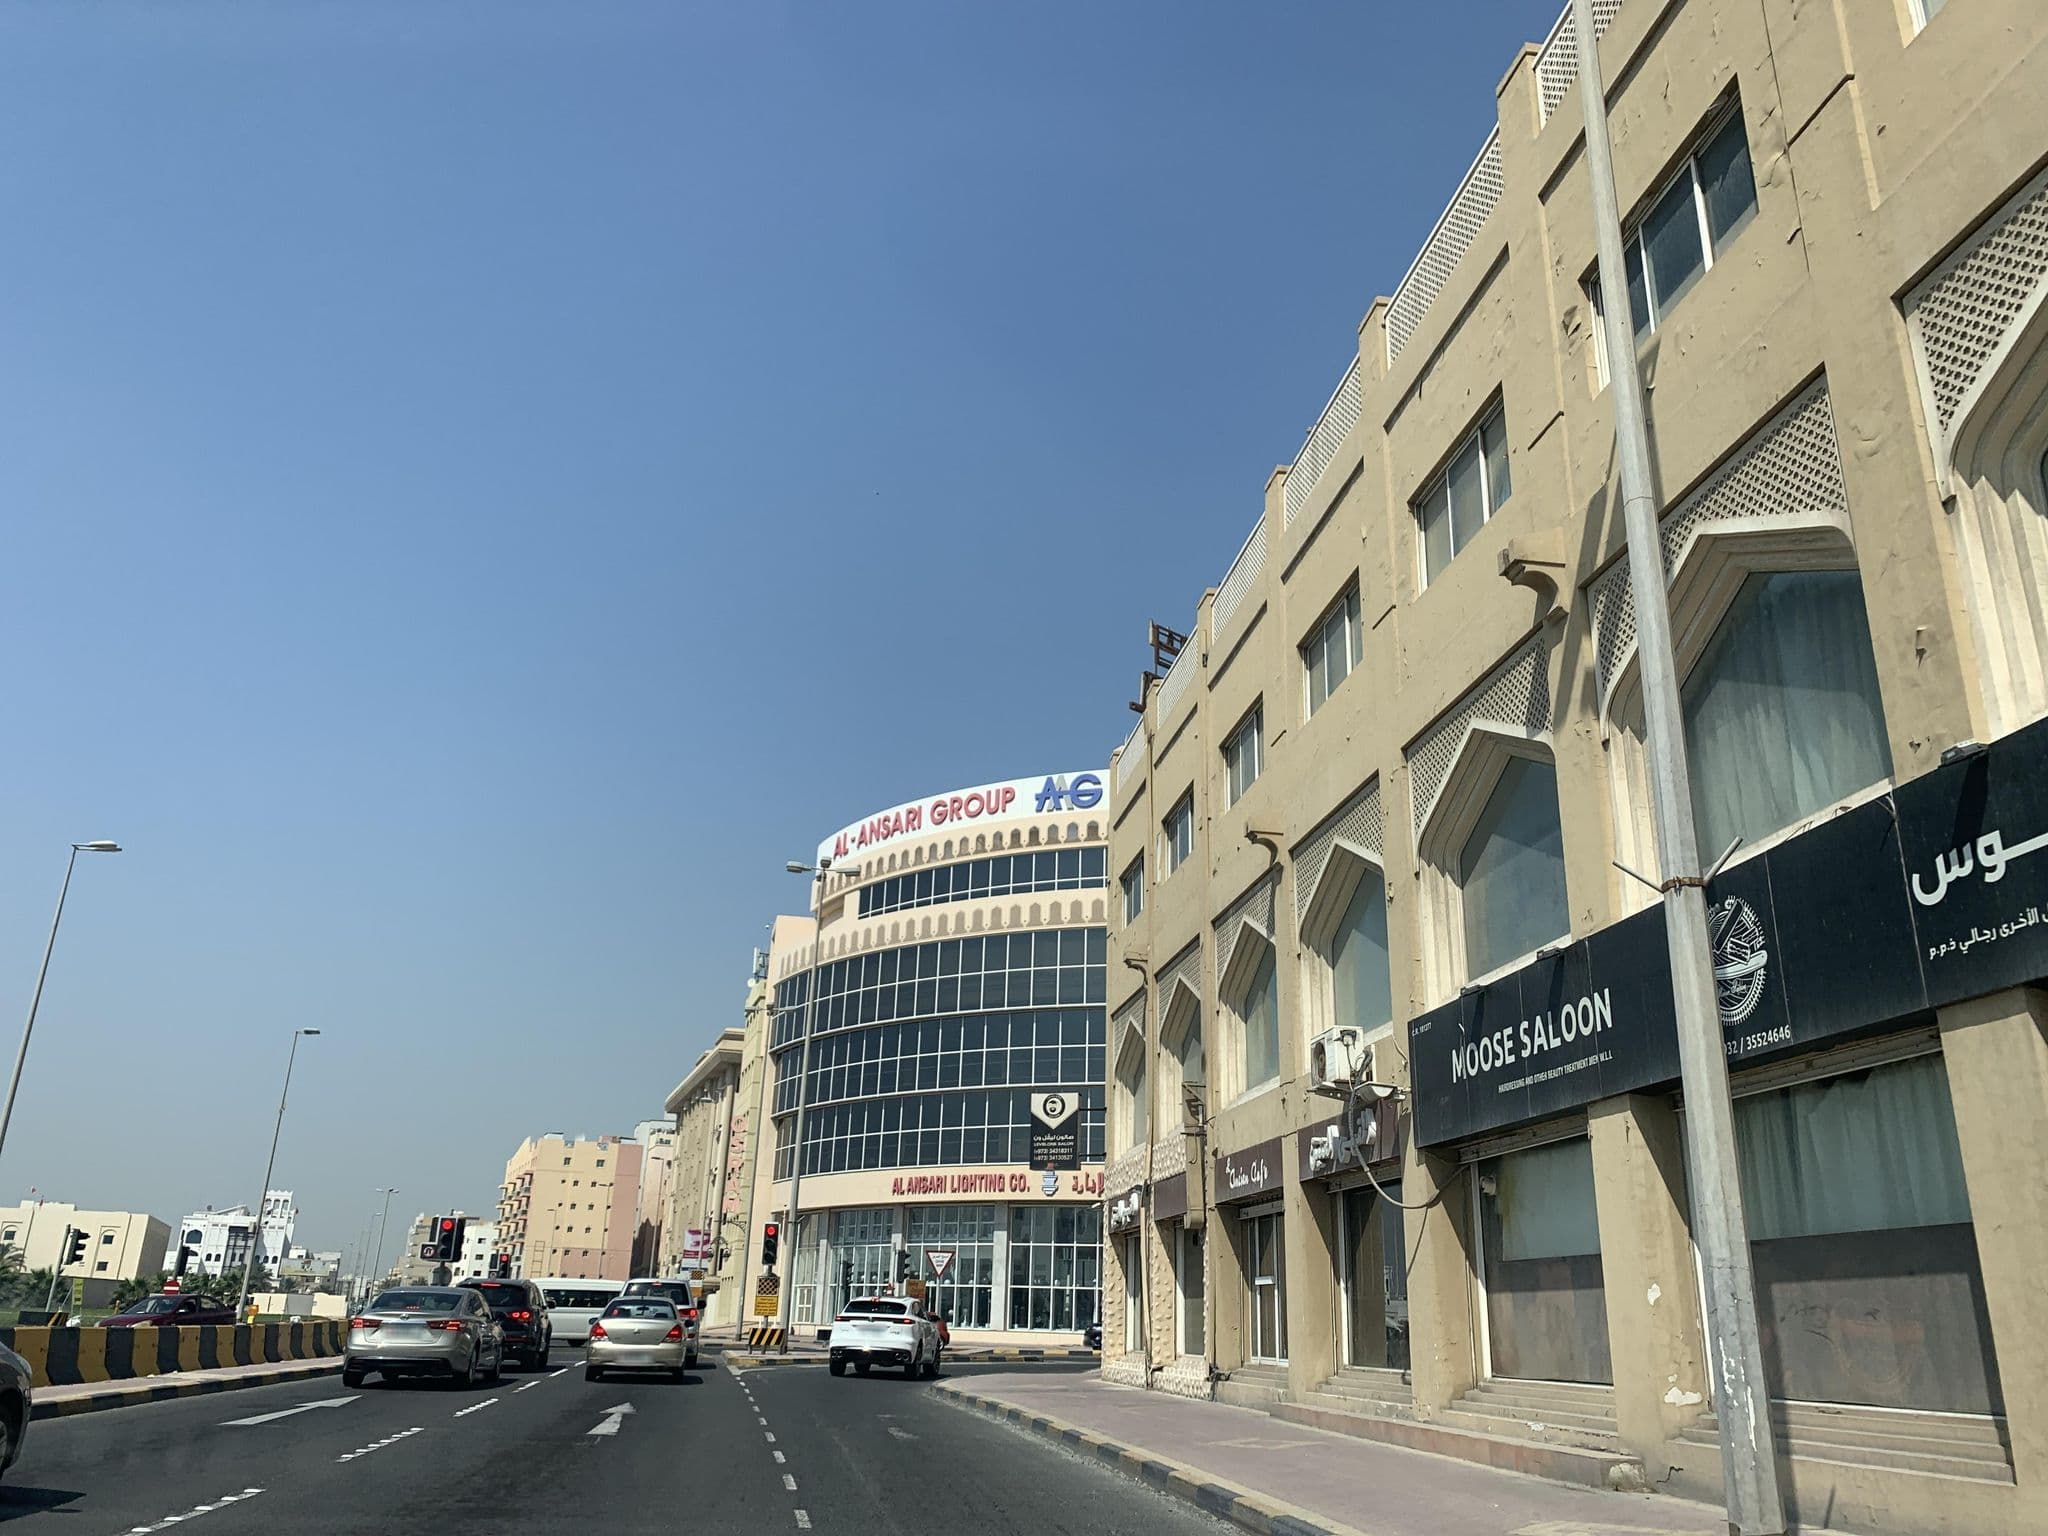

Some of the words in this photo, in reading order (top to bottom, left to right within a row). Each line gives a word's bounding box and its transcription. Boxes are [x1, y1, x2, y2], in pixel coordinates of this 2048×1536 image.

[930, 786, 1016, 826] GROUP
[1912, 829, 2048, 906] وس
[1959, 927, 1997, 954] رجالي
[1452, 1026, 1516, 1084] MOOSE
[1519, 987, 1613, 1058] SALOON
[1746, 1024, 1791, 1050] 35524646
[1525, 1075, 1534, 1086] AND
[1534, 1071, 1548, 1084] OTHER
[1548, 1066, 1564, 1080] BEAUTY
[1564, 1057, 1588, 1074] TREATMENT
[892, 1176, 905, 1196] AL
[907, 1174, 947, 1195] ANSARI
[950, 1172, 1005, 1194] LIGHTING
[1009, 1172, 1030, 1193] CO.
